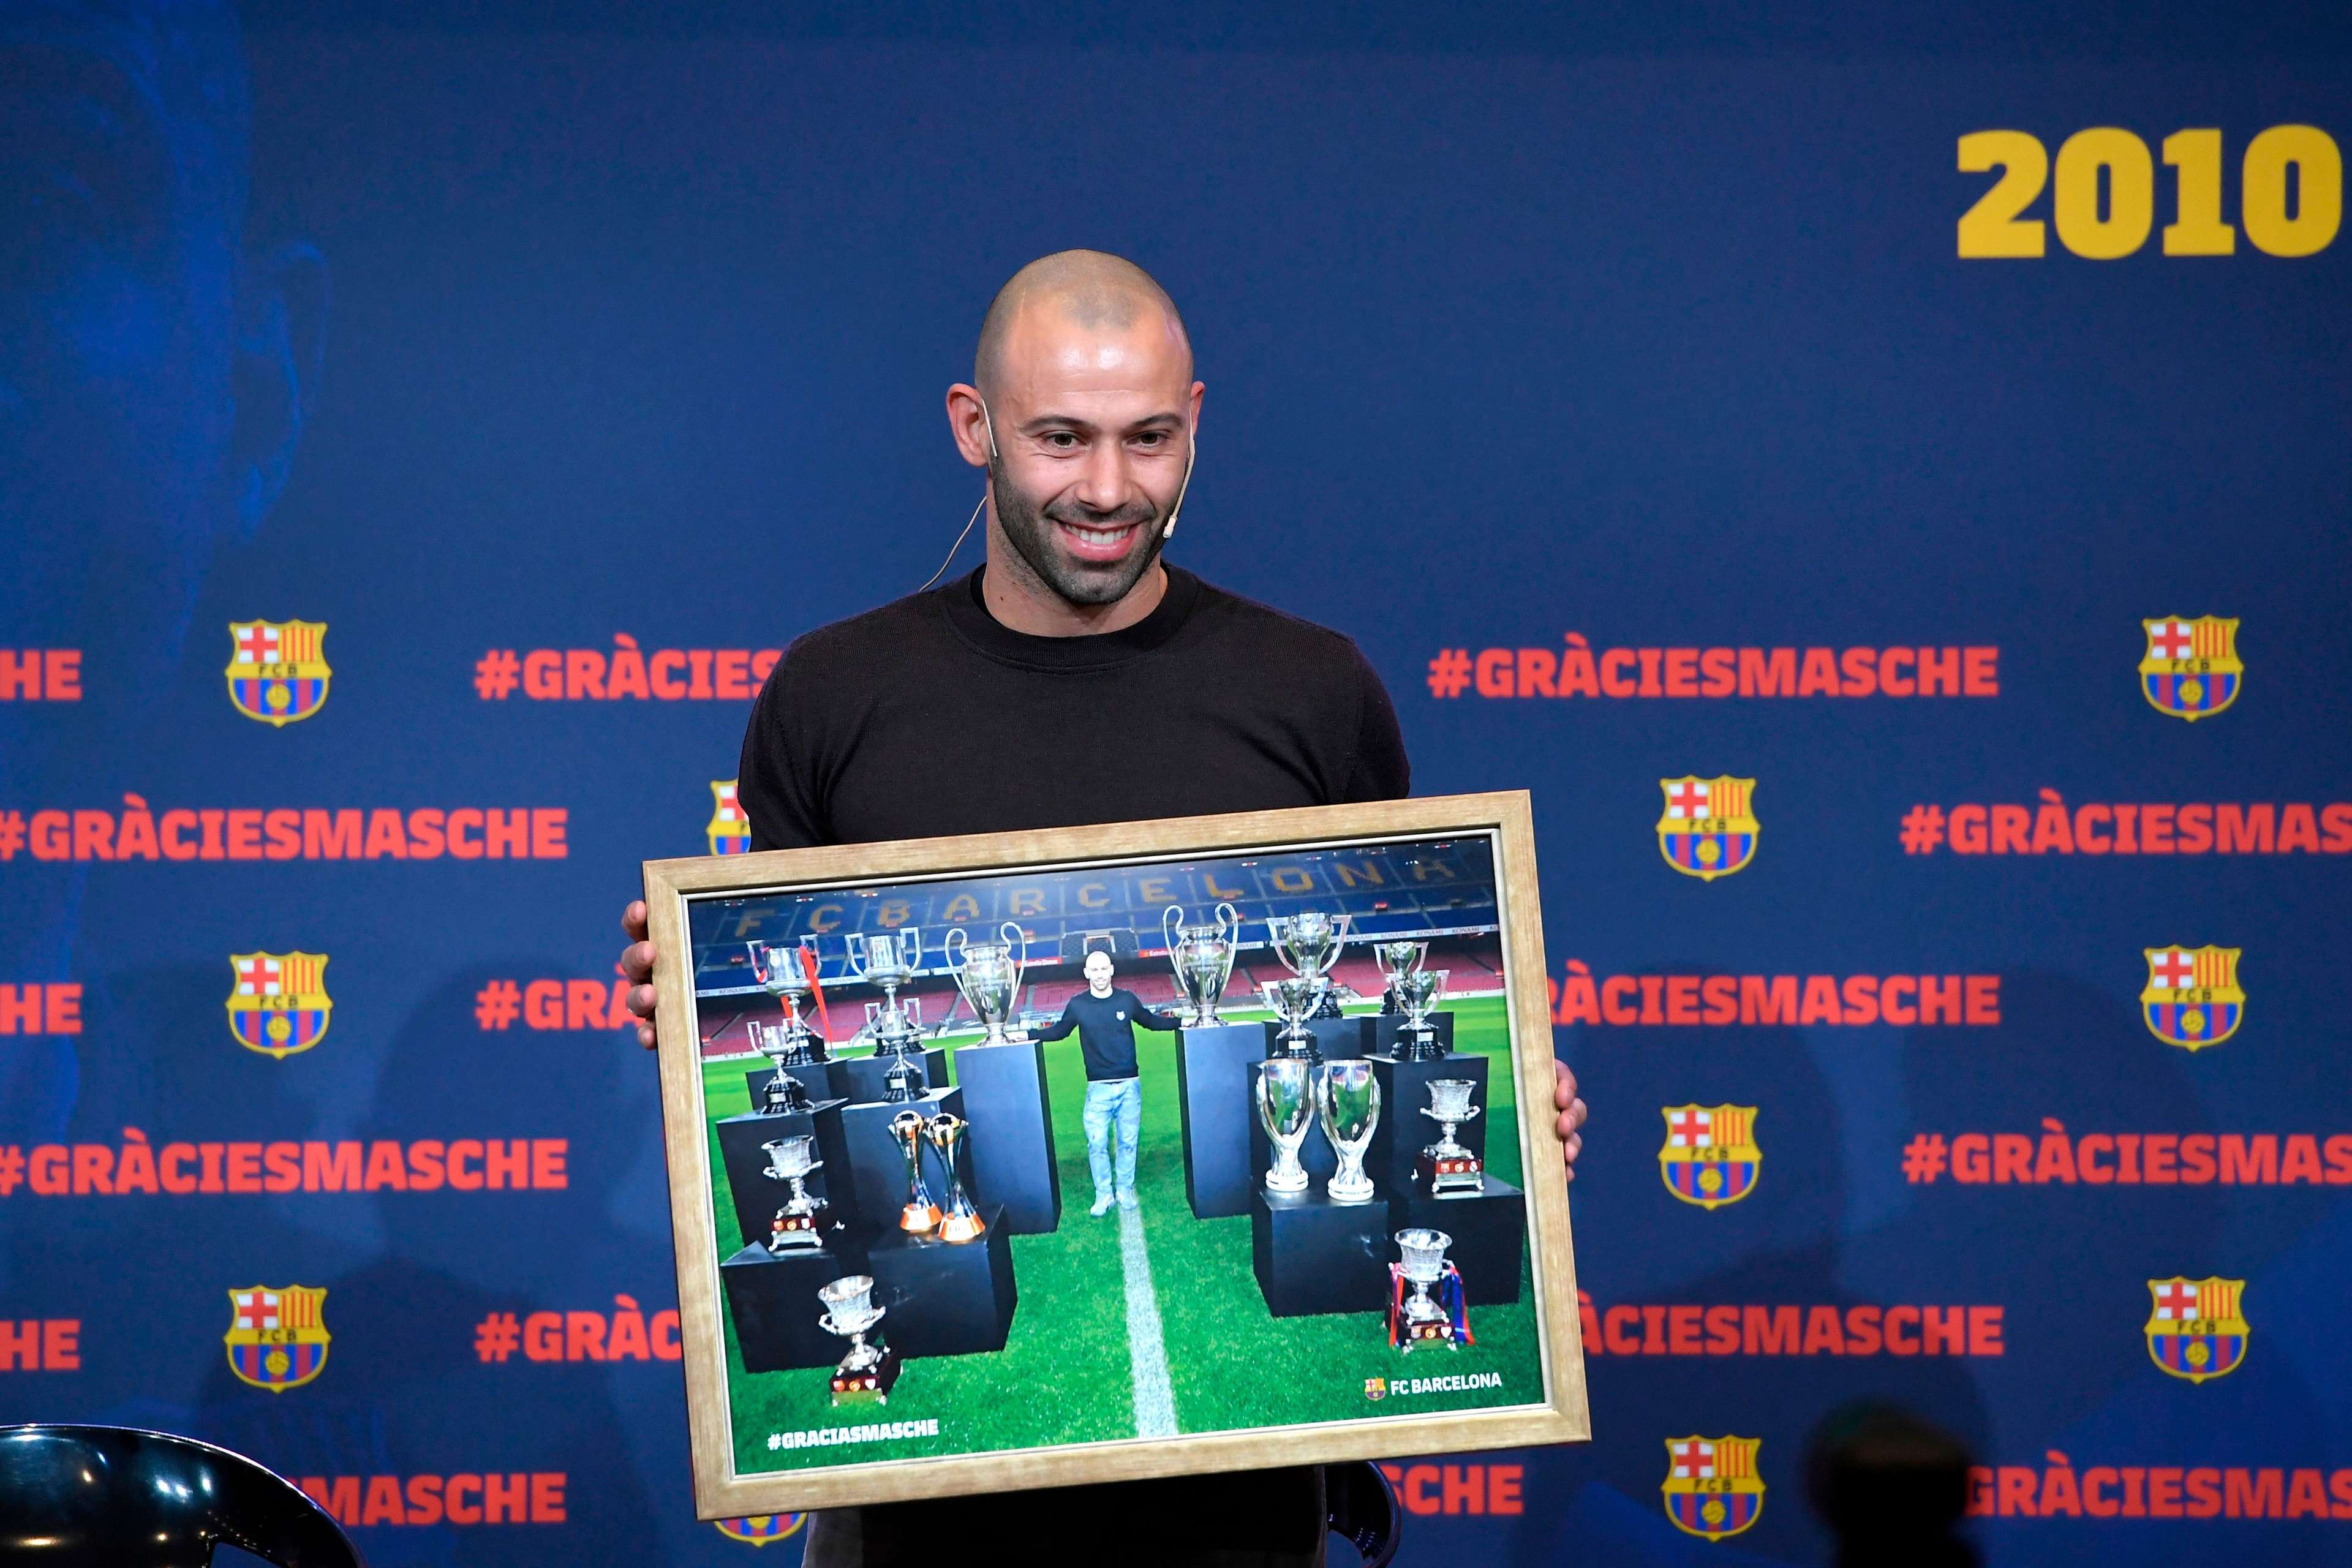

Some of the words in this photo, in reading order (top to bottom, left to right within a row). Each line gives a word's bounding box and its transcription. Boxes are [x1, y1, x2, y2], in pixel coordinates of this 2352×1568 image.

[1957, 124, 2343, 260] 2010
[1427, 632, 1999, 698] #GRÀCIESMASCHE
[1390, 1379, 1409, 1396] FC
[1411, 1372, 1502, 1394] BARCELONA
[767, 1419, 940, 1451] #GRACIASMASCHE
[285, 1472, 566, 1525] MASCHE
